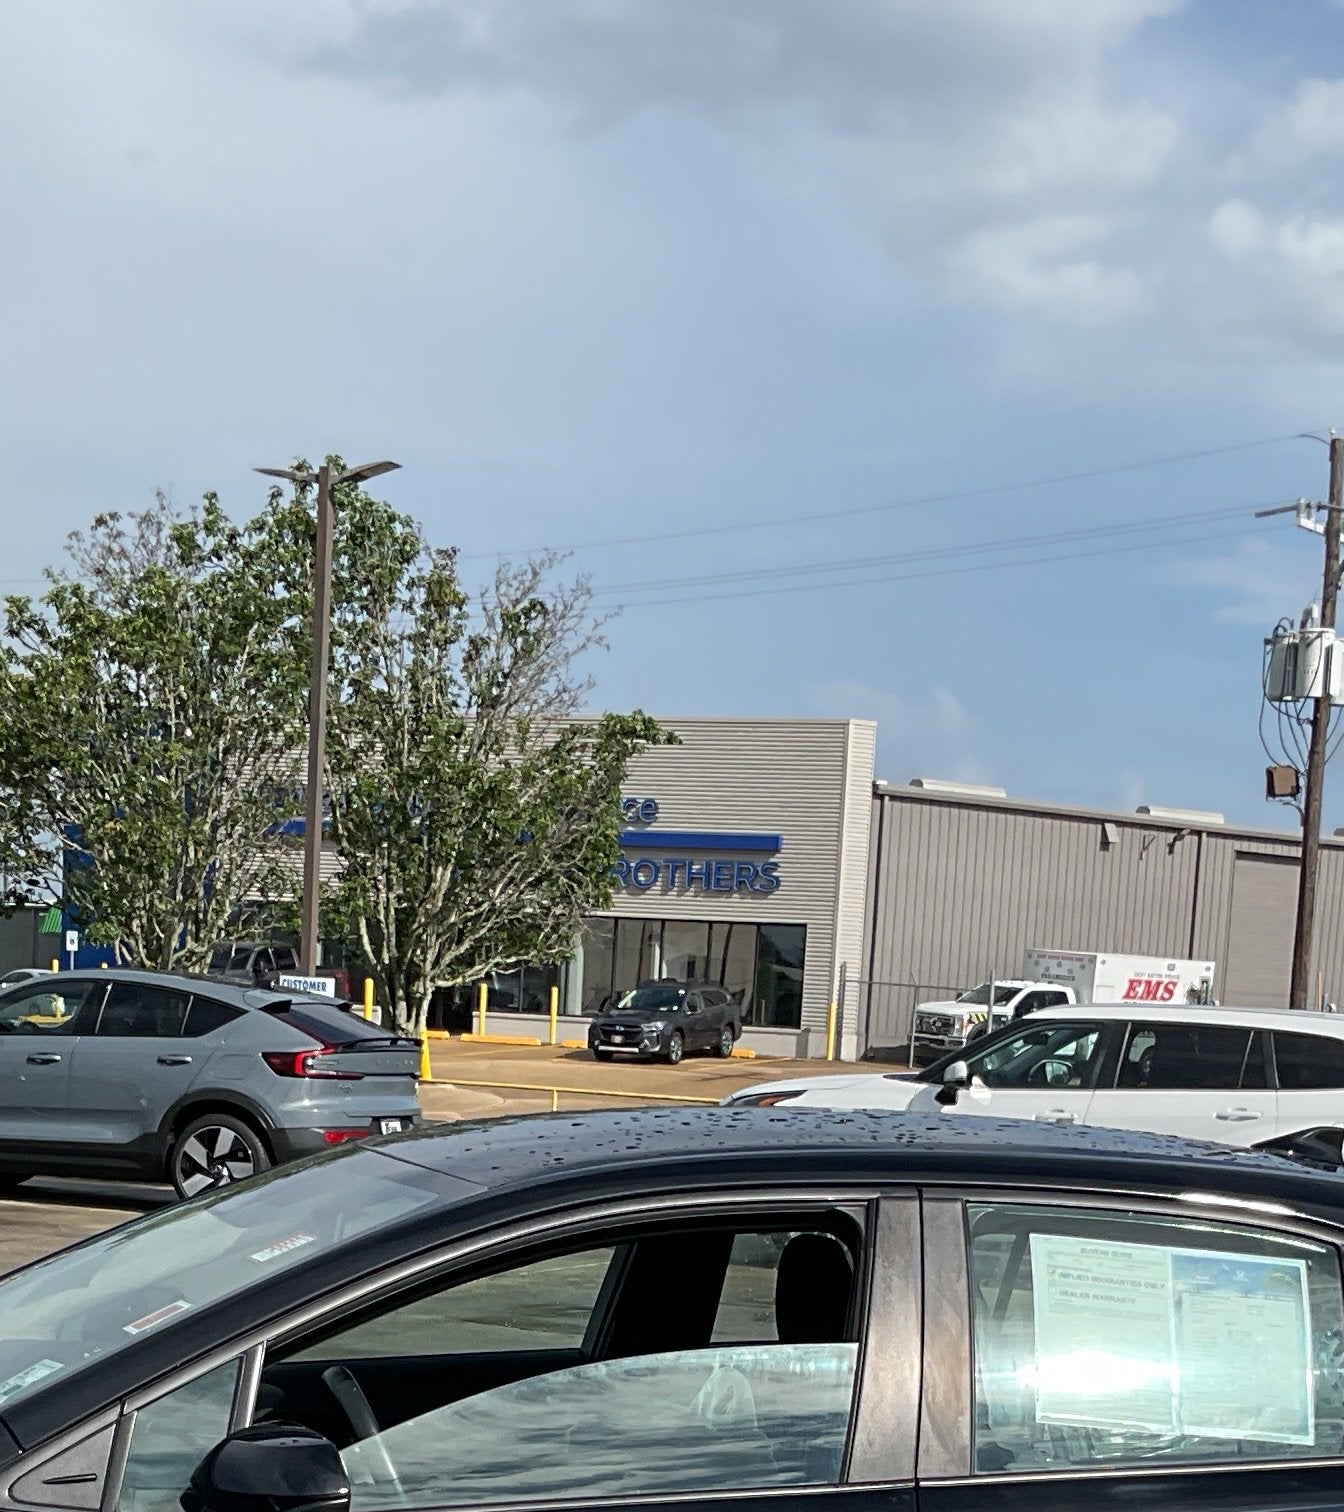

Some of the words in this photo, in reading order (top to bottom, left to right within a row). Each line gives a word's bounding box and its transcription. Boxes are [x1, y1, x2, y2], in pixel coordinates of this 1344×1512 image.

[609, 858, 782, 893] ROTHERS
[1122, 978, 1178, 1001] EMS
[1058, 1289, 1090, 1299] DEALER
